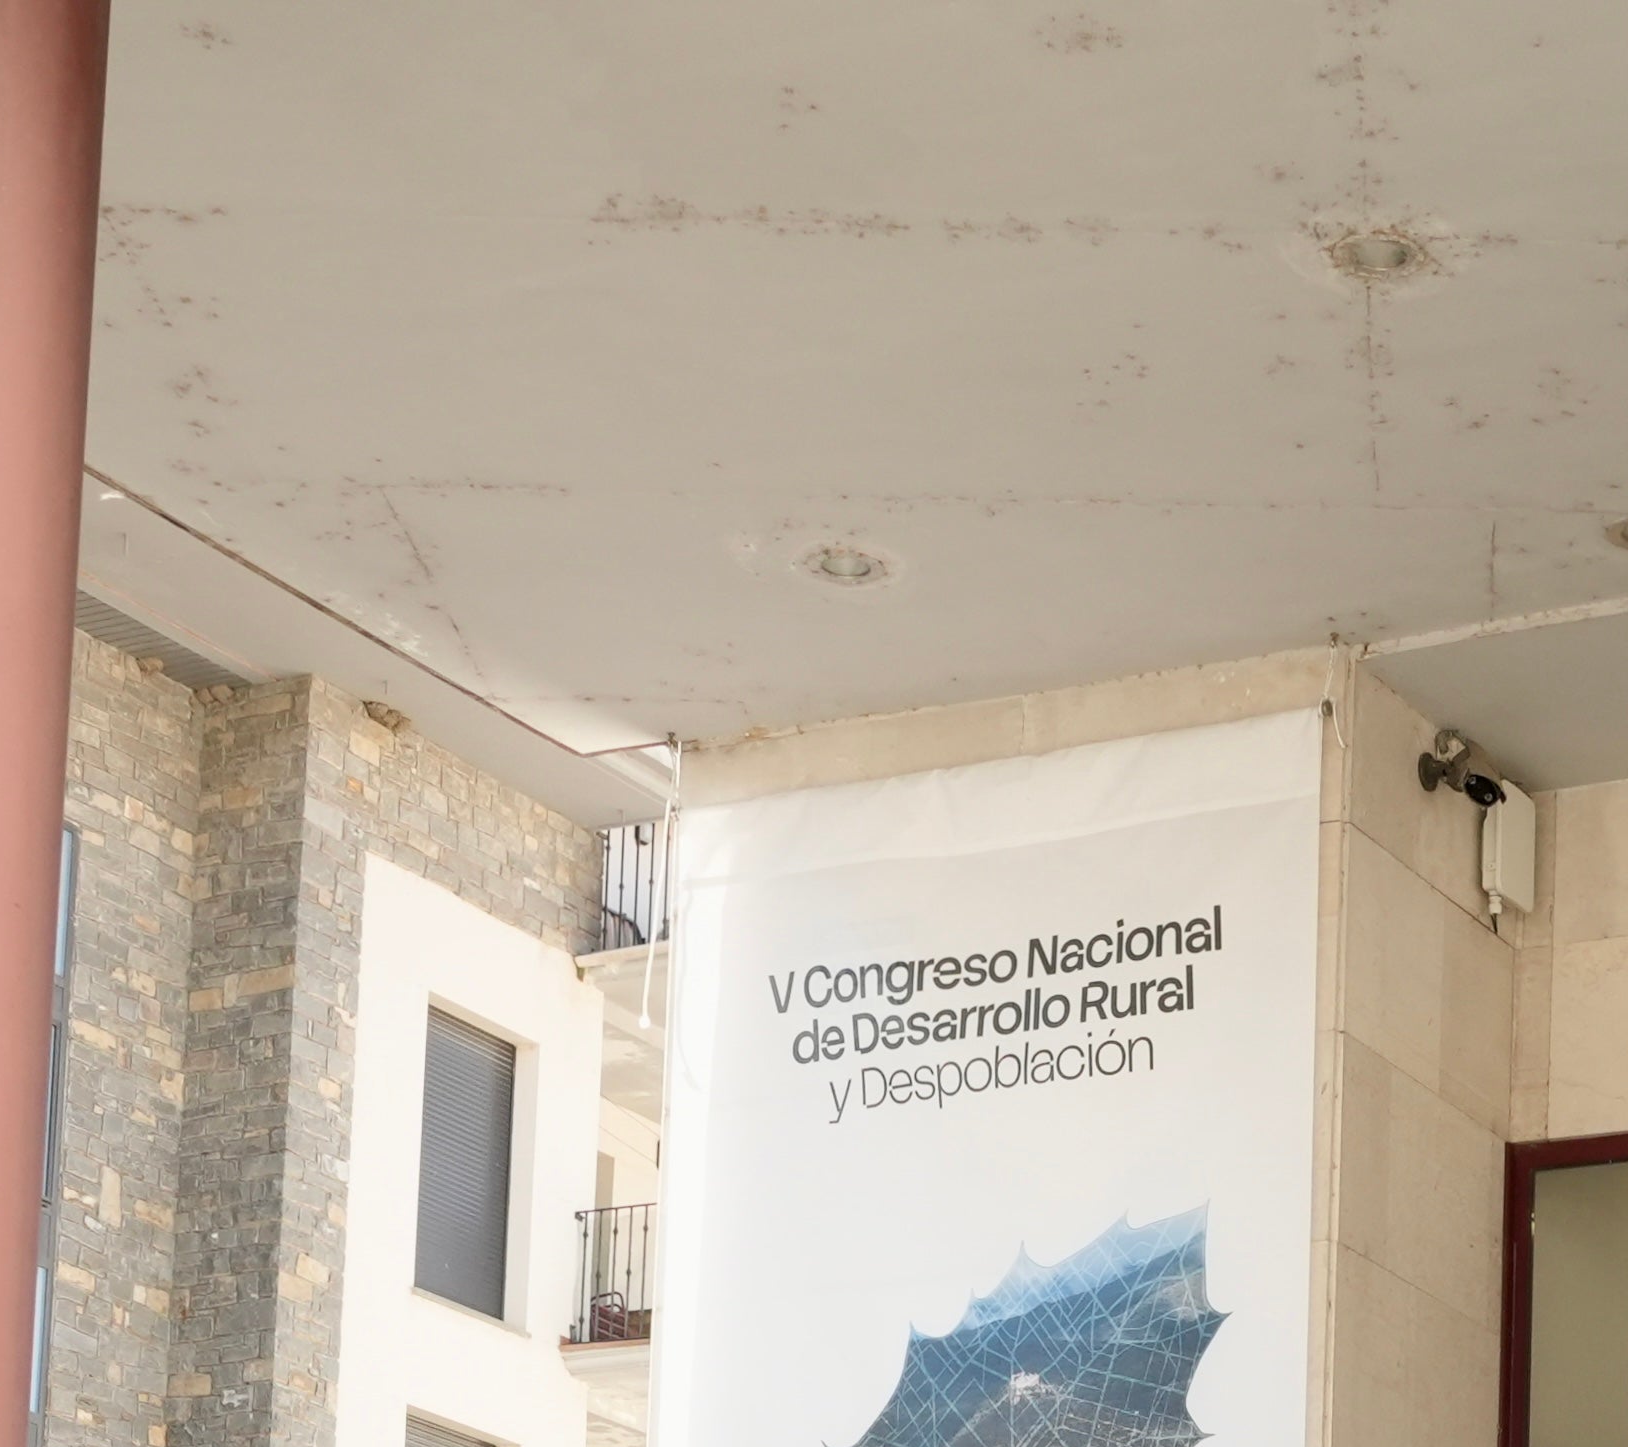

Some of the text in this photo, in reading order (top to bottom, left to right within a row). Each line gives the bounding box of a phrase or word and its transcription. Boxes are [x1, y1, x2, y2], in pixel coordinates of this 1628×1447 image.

[768, 905, 1222, 1013] V Congreso Nacional
[793, 965, 1194, 1064] de Desarrollo Rural
[829, 1029, 1154, 1124] y Despoblación
